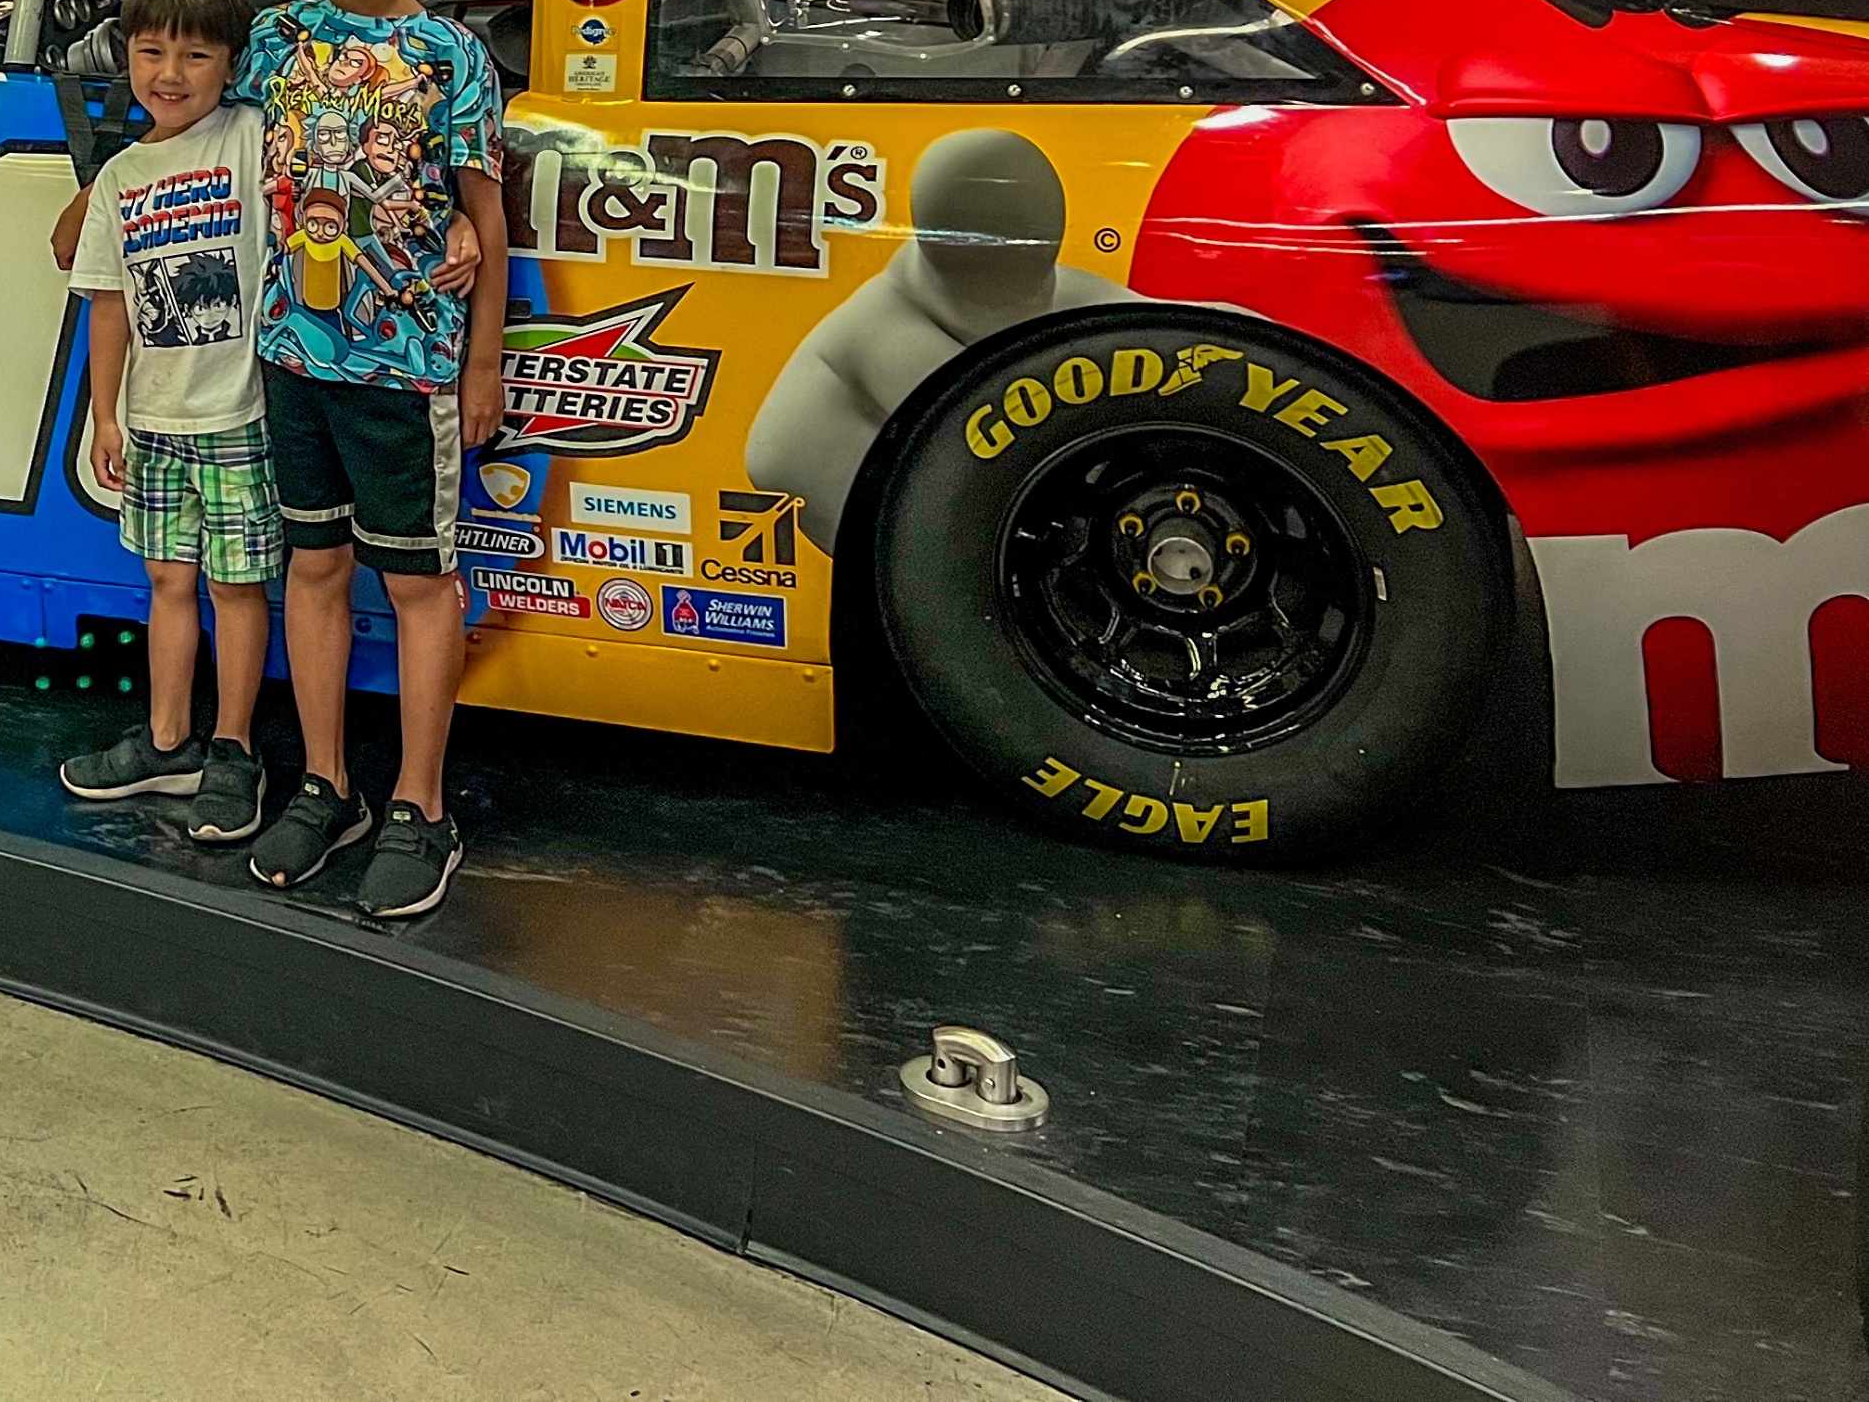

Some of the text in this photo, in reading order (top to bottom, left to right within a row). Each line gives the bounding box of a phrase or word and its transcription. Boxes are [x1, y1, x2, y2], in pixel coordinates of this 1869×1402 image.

[152, 166, 232, 211] HERO
[122, 199, 243, 255] CADEMIA
[501, 352, 692, 394] TERSTATE
[507, 386, 675, 425] TTERIES
[583, 496, 677, 520] SIEMENS
[455, 528, 530, 553] HTLINER
[559, 531, 646, 565] Mobil
[477, 571, 570, 598] LINCOLN
[700, 558, 797, 588] Cessna
[497, 593, 580, 616] WELDERS
[708, 598, 773, 617] SHERWIN
[705, 610, 775, 631] WILLIAMS
[1020, 755, 1269, 844] EAGLE
